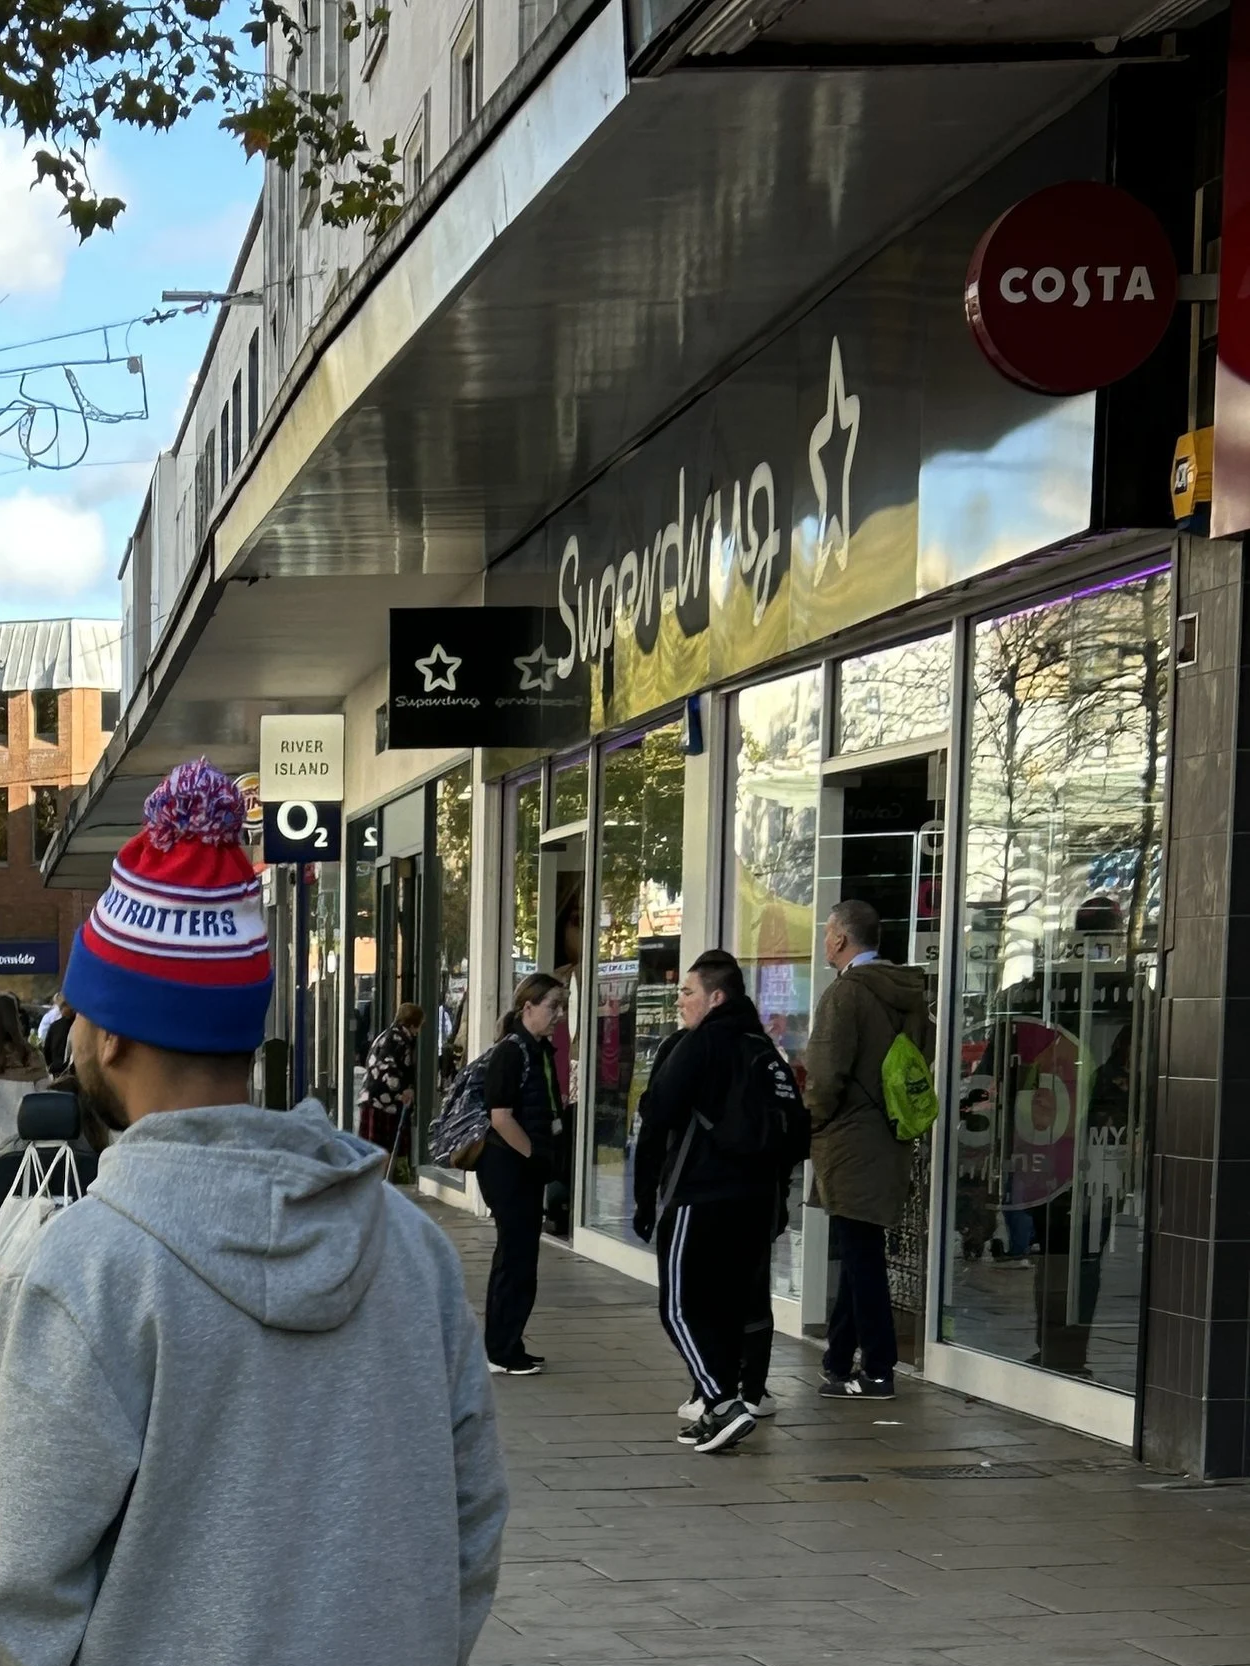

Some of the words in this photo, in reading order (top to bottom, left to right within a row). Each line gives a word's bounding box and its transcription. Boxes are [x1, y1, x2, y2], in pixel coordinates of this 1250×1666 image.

[999, 266, 1155, 307] COSTA
[557, 461, 780, 692] Superdrug
[395, 695, 481, 708] Superdrug
[280, 740, 323, 753] RIVER
[275, 762, 329, 776] ISLAND
